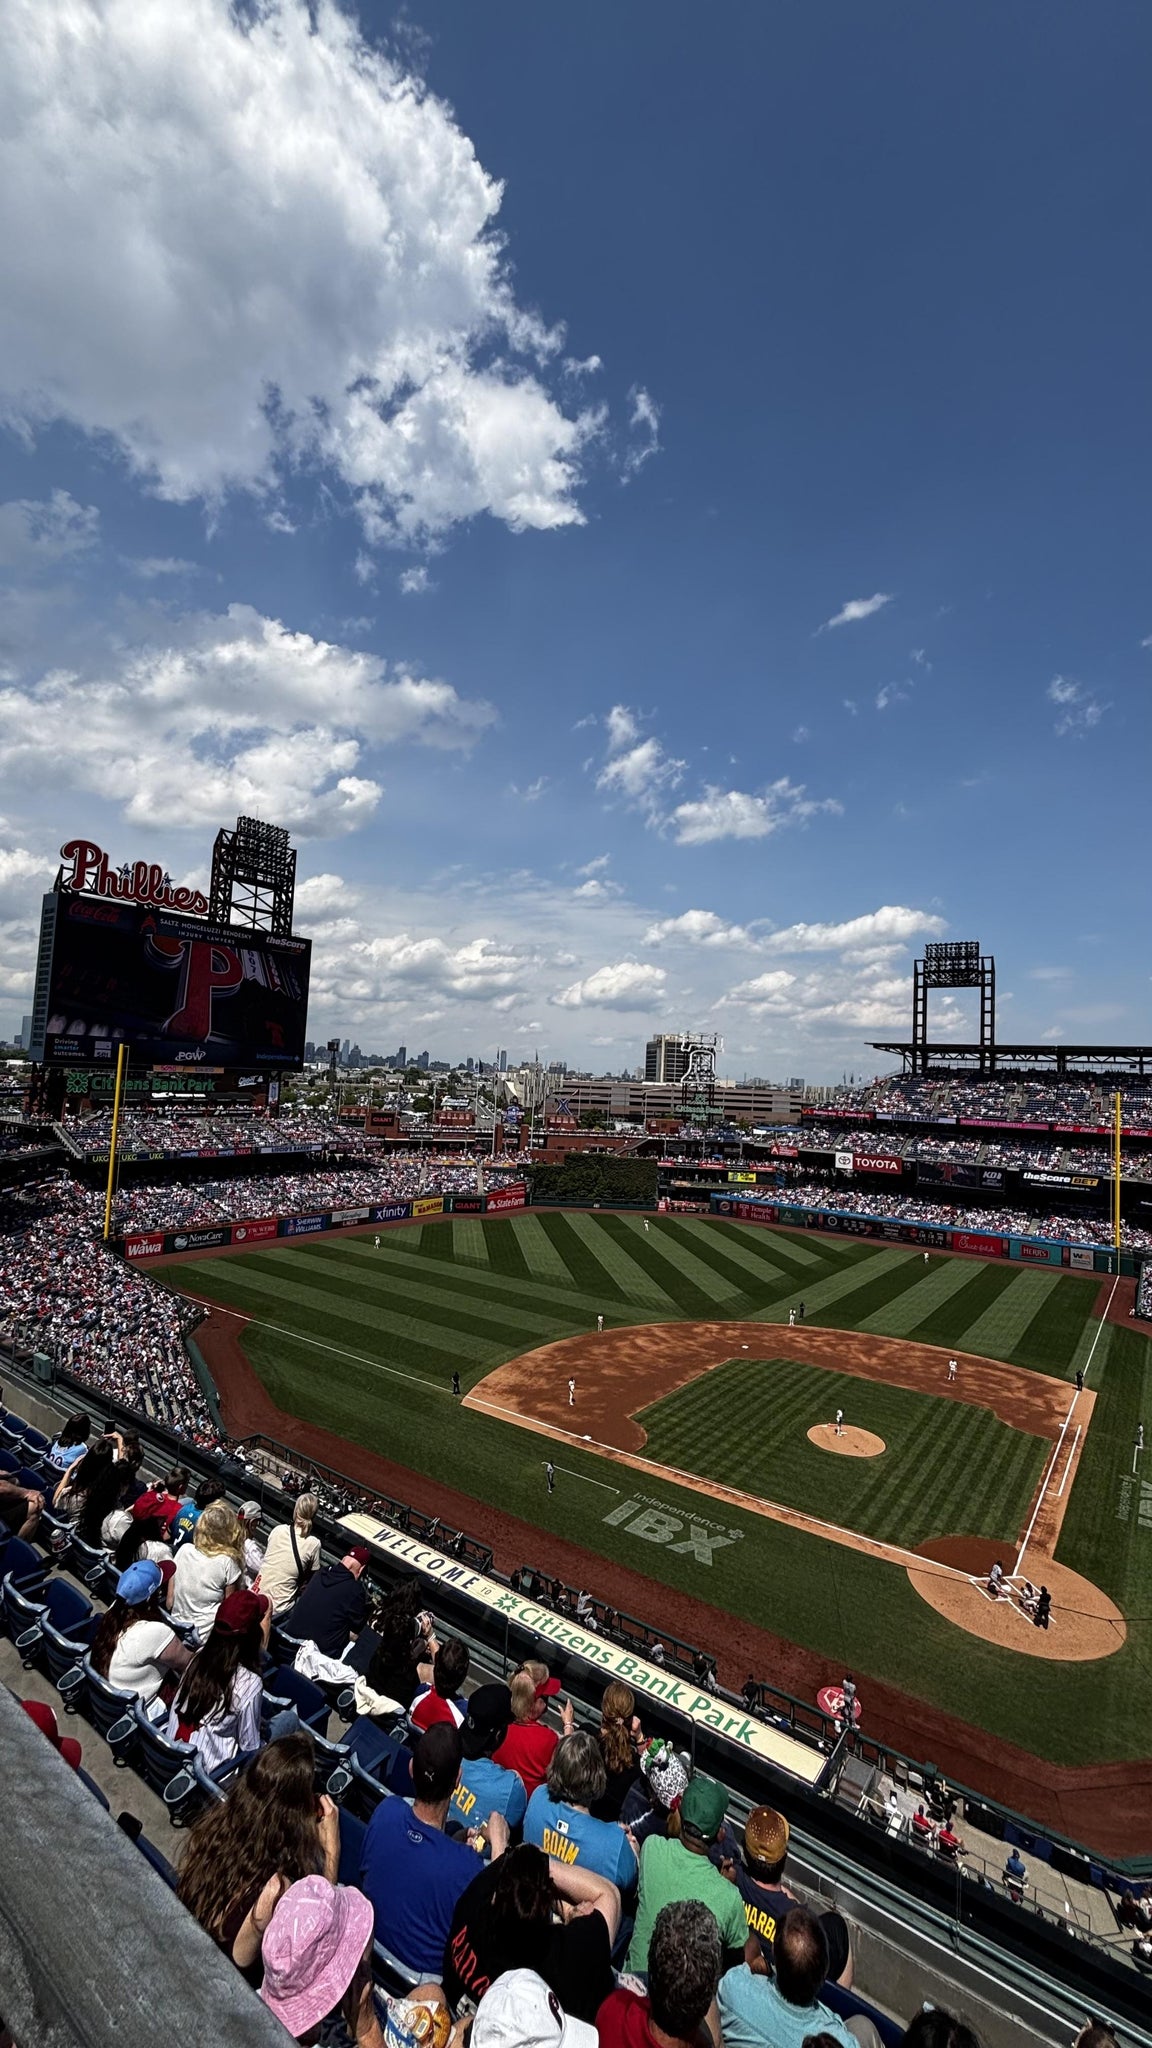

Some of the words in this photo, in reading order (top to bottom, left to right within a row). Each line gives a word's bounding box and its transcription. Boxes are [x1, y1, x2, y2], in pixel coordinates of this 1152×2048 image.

[61, 840, 209, 914] Phillies
[68, 899, 122, 924] Coca-Cola
[160, 918, 179, 927] SALTZ
[181, 922, 221, 934] MONGELUZZI
[178, 929, 203, 939] INJURY
[206, 935, 235, 945] LAWYERS
[265, 935, 307, 950] theScore
[54, 1038, 79, 1046] Driving
[177, 1050, 205, 1062] PGW
[152, 1077, 187, 1092] Bank
[188, 1078, 217, 1092] Park
[675, 1104, 705, 1114] Citizens
[705, 1105, 724, 1115] Bank
[691, 1113, 709, 1121] Park
[92, 1154, 109, 1163] UKG
[121, 1153, 138, 1161] UKG
[149, 1152, 165, 1160] UKG
[855, 1158, 898, 1170] TOYOTA
[1023, 1171, 1071, 1183] theScore
[1073, 1177, 1097, 1186] BET
[376, 1205, 406, 1221] xfinity
[750, 1205, 772, 1213] Temple
[750, 1212, 771, 1220] Health
[296, 1217, 322, 1226] SHERWIN
[188, 1231, 224, 1243] NovaCare
[128, 1242, 162, 1257] Wawa
[633, 1491, 726, 1532] Independence
[601, 1499, 736, 1567] IBX
[372, 1528, 481, 1590] WELCOME
[480, 1585, 492, 1596] TO
[518, 1606, 615, 1665] Citizens
[614, 1656, 688, 1707] Bank
[687, 1695, 760, 1747] Park
[450, 1782, 477, 1816] PER
[543, 1827, 579, 1865] BOHM
